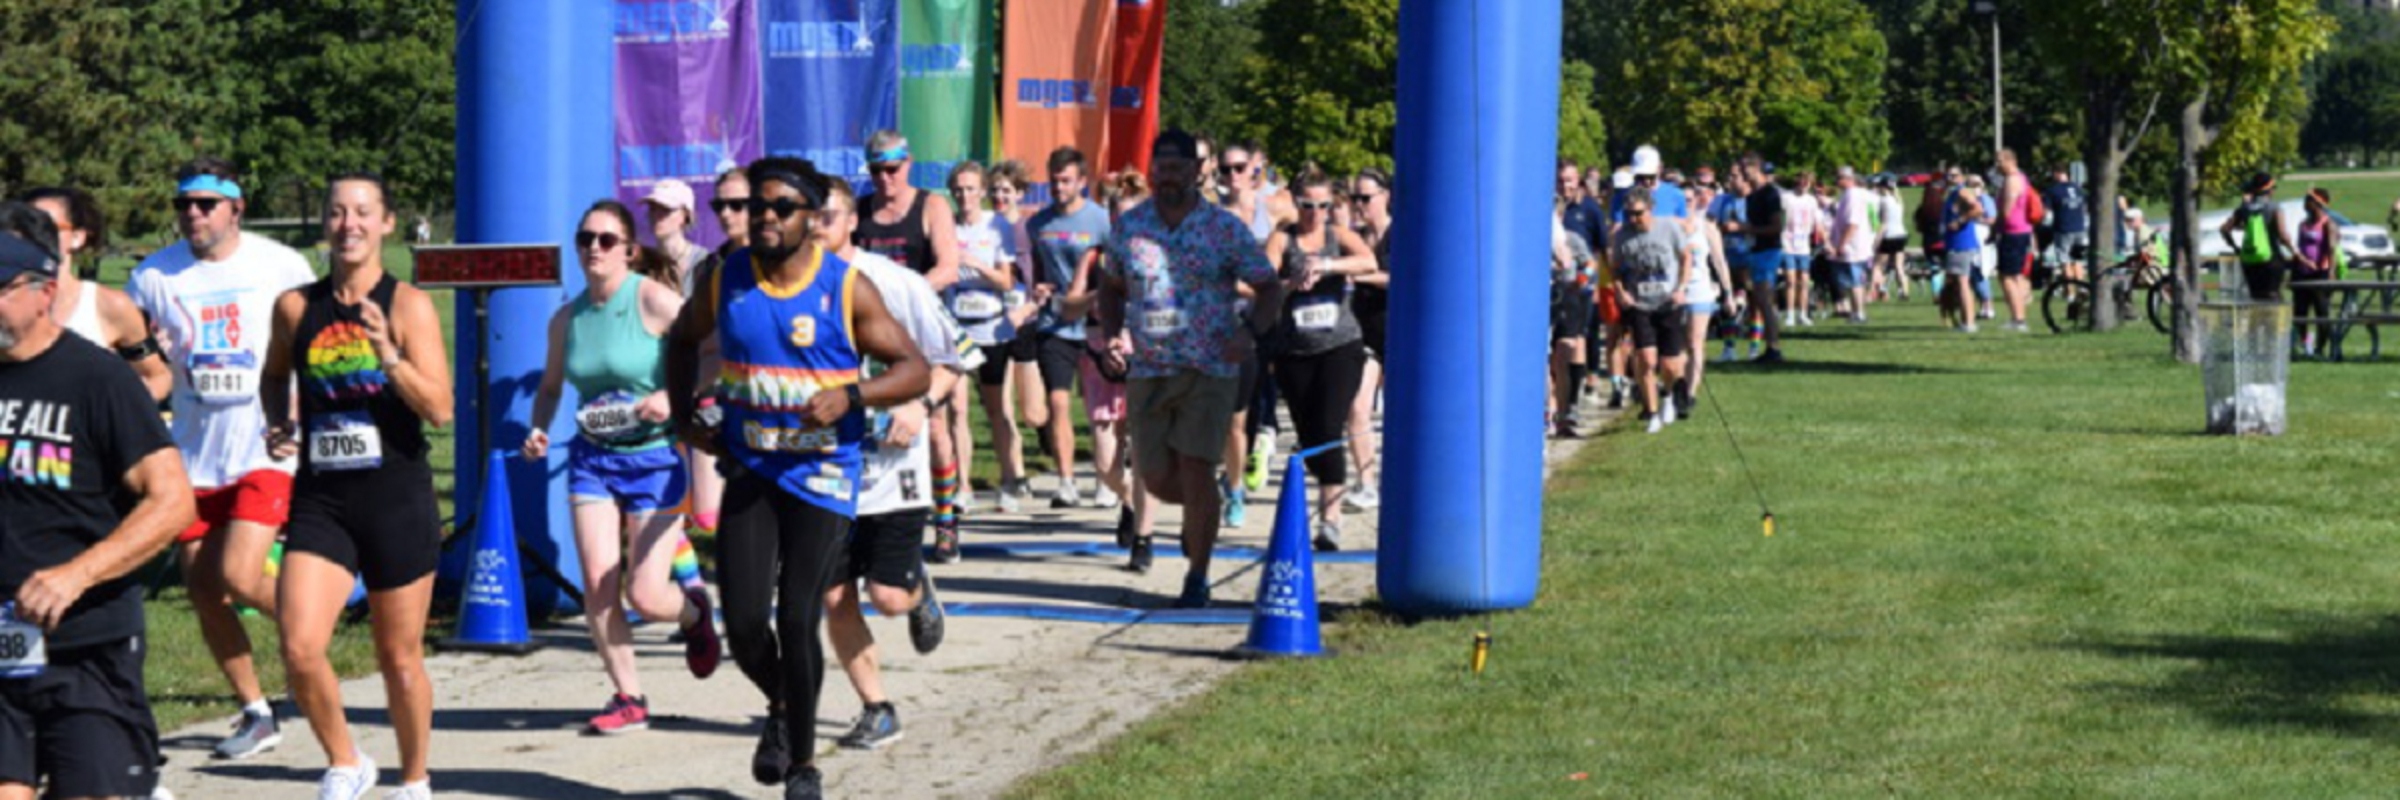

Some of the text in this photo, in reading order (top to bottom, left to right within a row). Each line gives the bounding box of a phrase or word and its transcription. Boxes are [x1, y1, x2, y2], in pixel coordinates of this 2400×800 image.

[790, 315, 816, 346] 3
[200, 373, 242, 392] 8141
[20, 400, 73, 443] ALL
[318, 433, 367, 457] 8705
